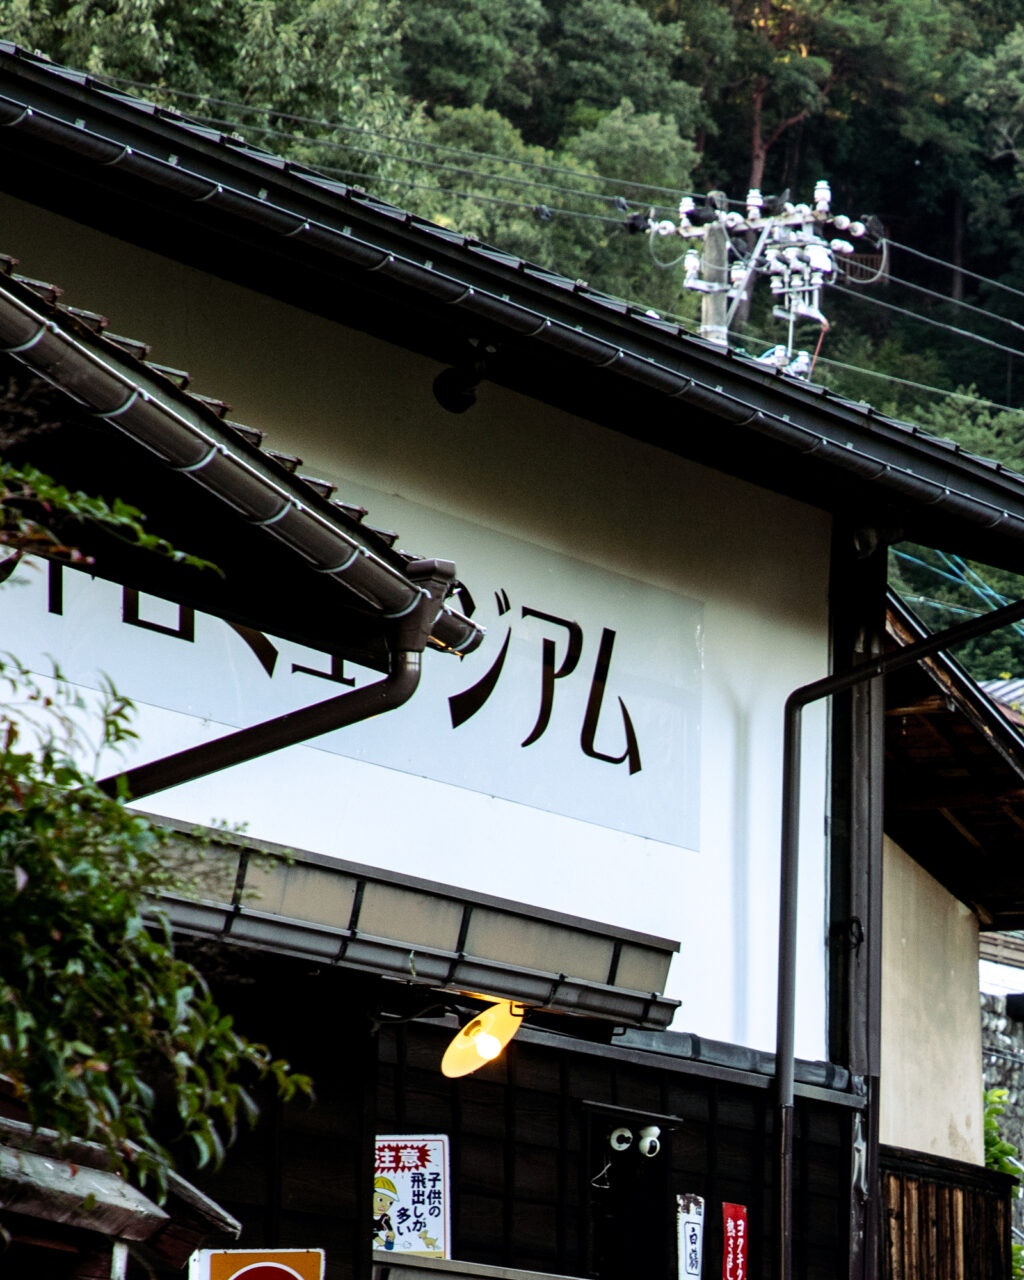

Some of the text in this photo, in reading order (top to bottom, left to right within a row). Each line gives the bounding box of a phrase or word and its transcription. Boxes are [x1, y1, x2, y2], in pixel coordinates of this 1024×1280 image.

[376, 1148, 421, 1168] 注意
[411, 1172, 427, 1232] 飛出しが
[427, 1172, 442, 1218] 子供の
[396, 1207, 411, 1236] 多い
